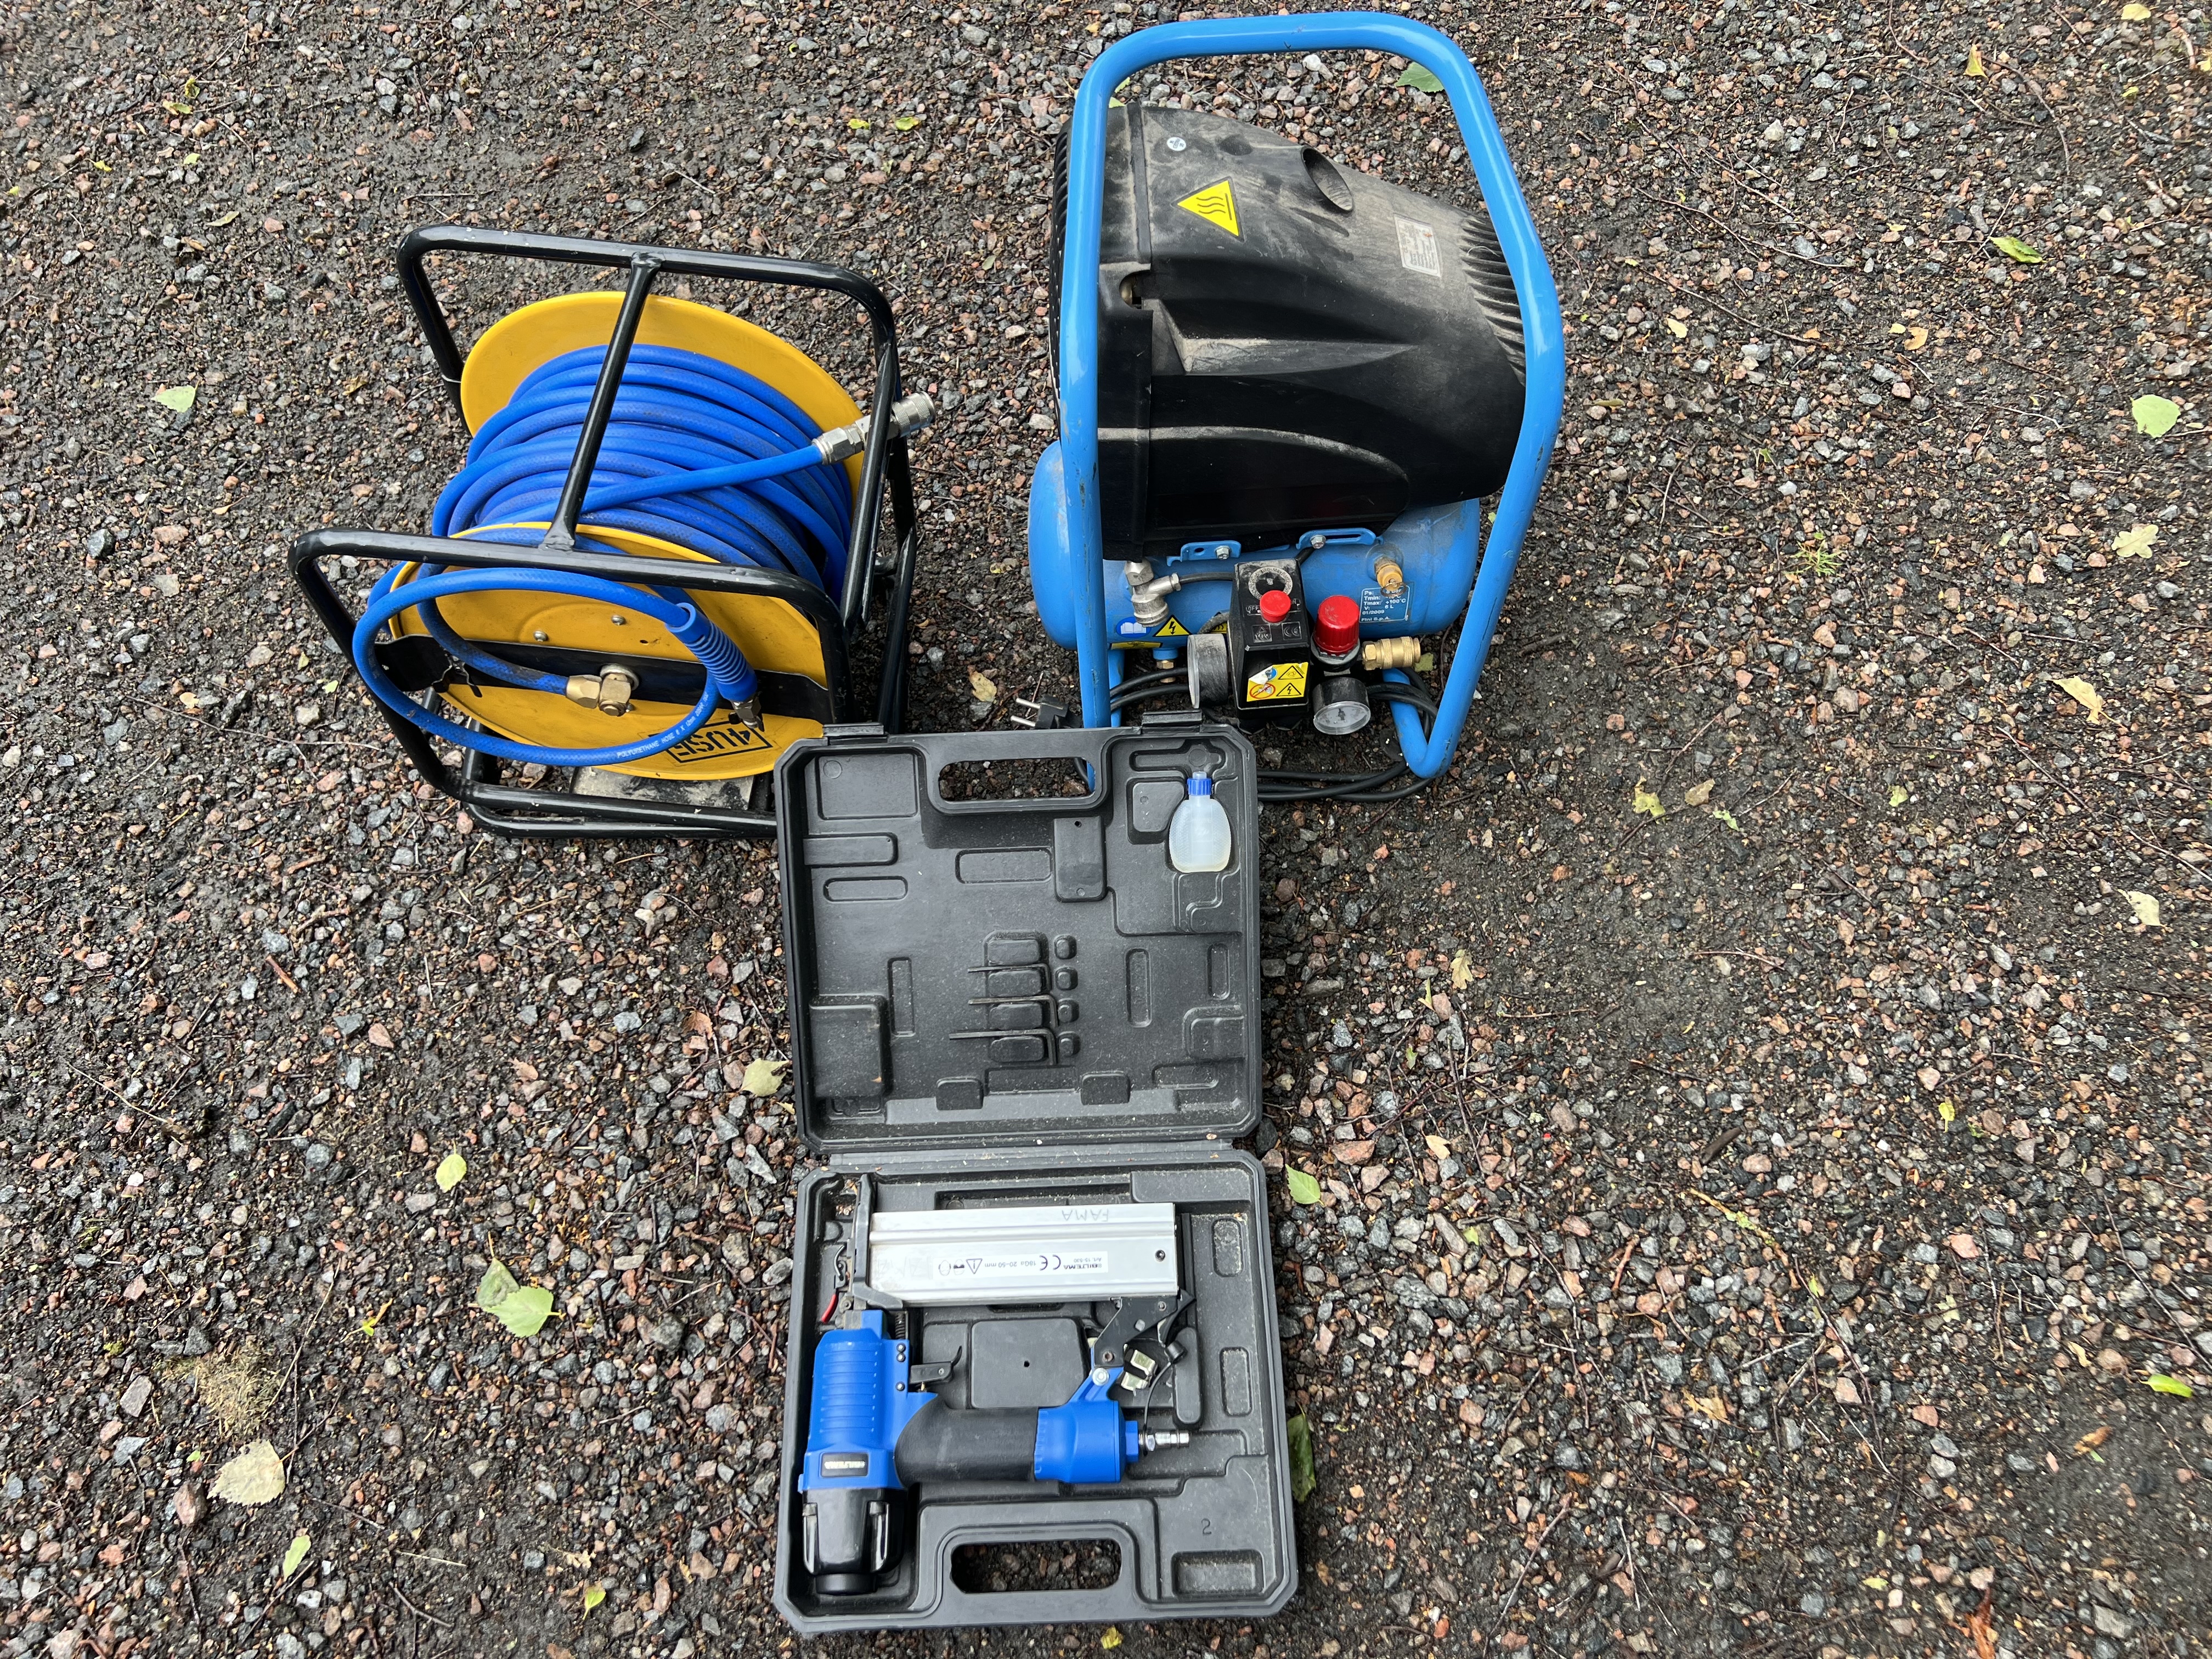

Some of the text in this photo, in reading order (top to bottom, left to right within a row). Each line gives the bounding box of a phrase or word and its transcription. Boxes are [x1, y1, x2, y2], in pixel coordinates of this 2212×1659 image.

[617, 741, 660, 759] POLYURETHANE
[661, 732, 675, 744] HOSE
[1062, 1208, 1109, 1222] FAMA
[1201, 1517, 1212, 1536] 2
